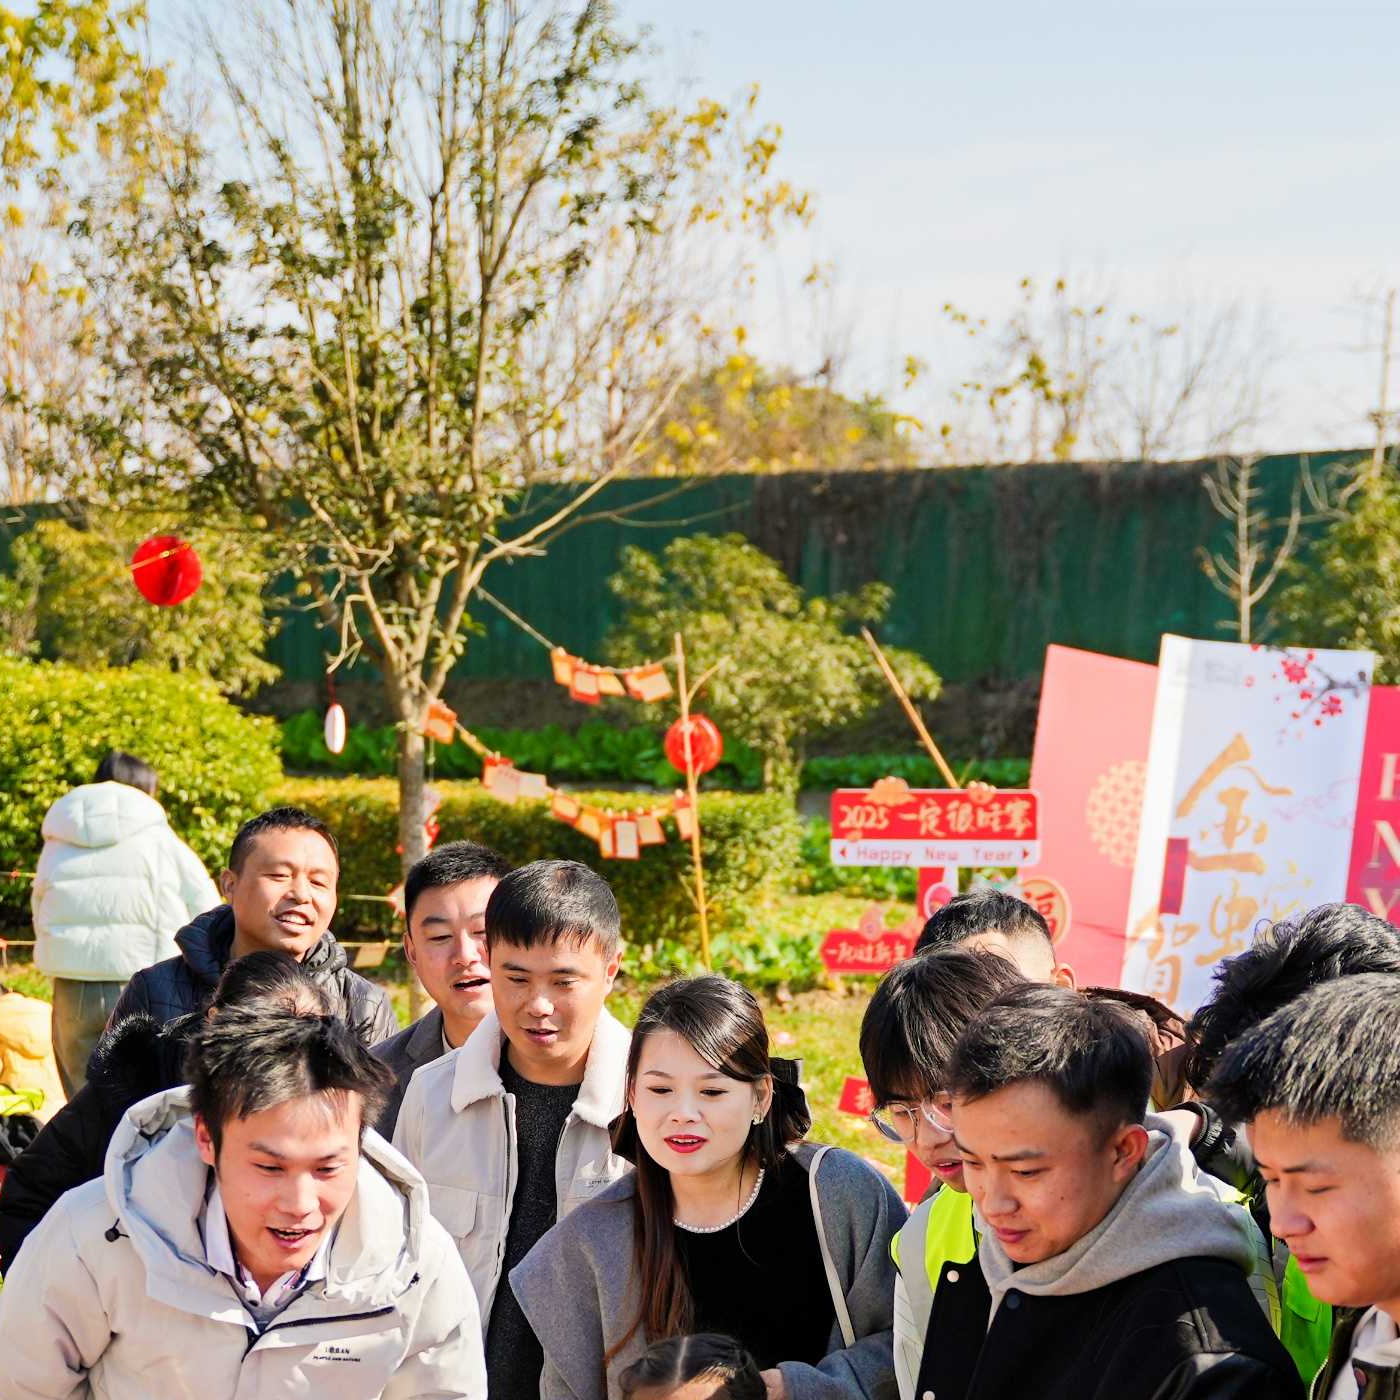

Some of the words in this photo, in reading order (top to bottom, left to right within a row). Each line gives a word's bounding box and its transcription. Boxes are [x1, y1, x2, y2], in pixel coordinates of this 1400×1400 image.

[838, 804, 889, 830] 2025
[856, 846, 912, 865] Happy
[925, 846, 959, 862] New
[973, 846, 1015, 862] Year
